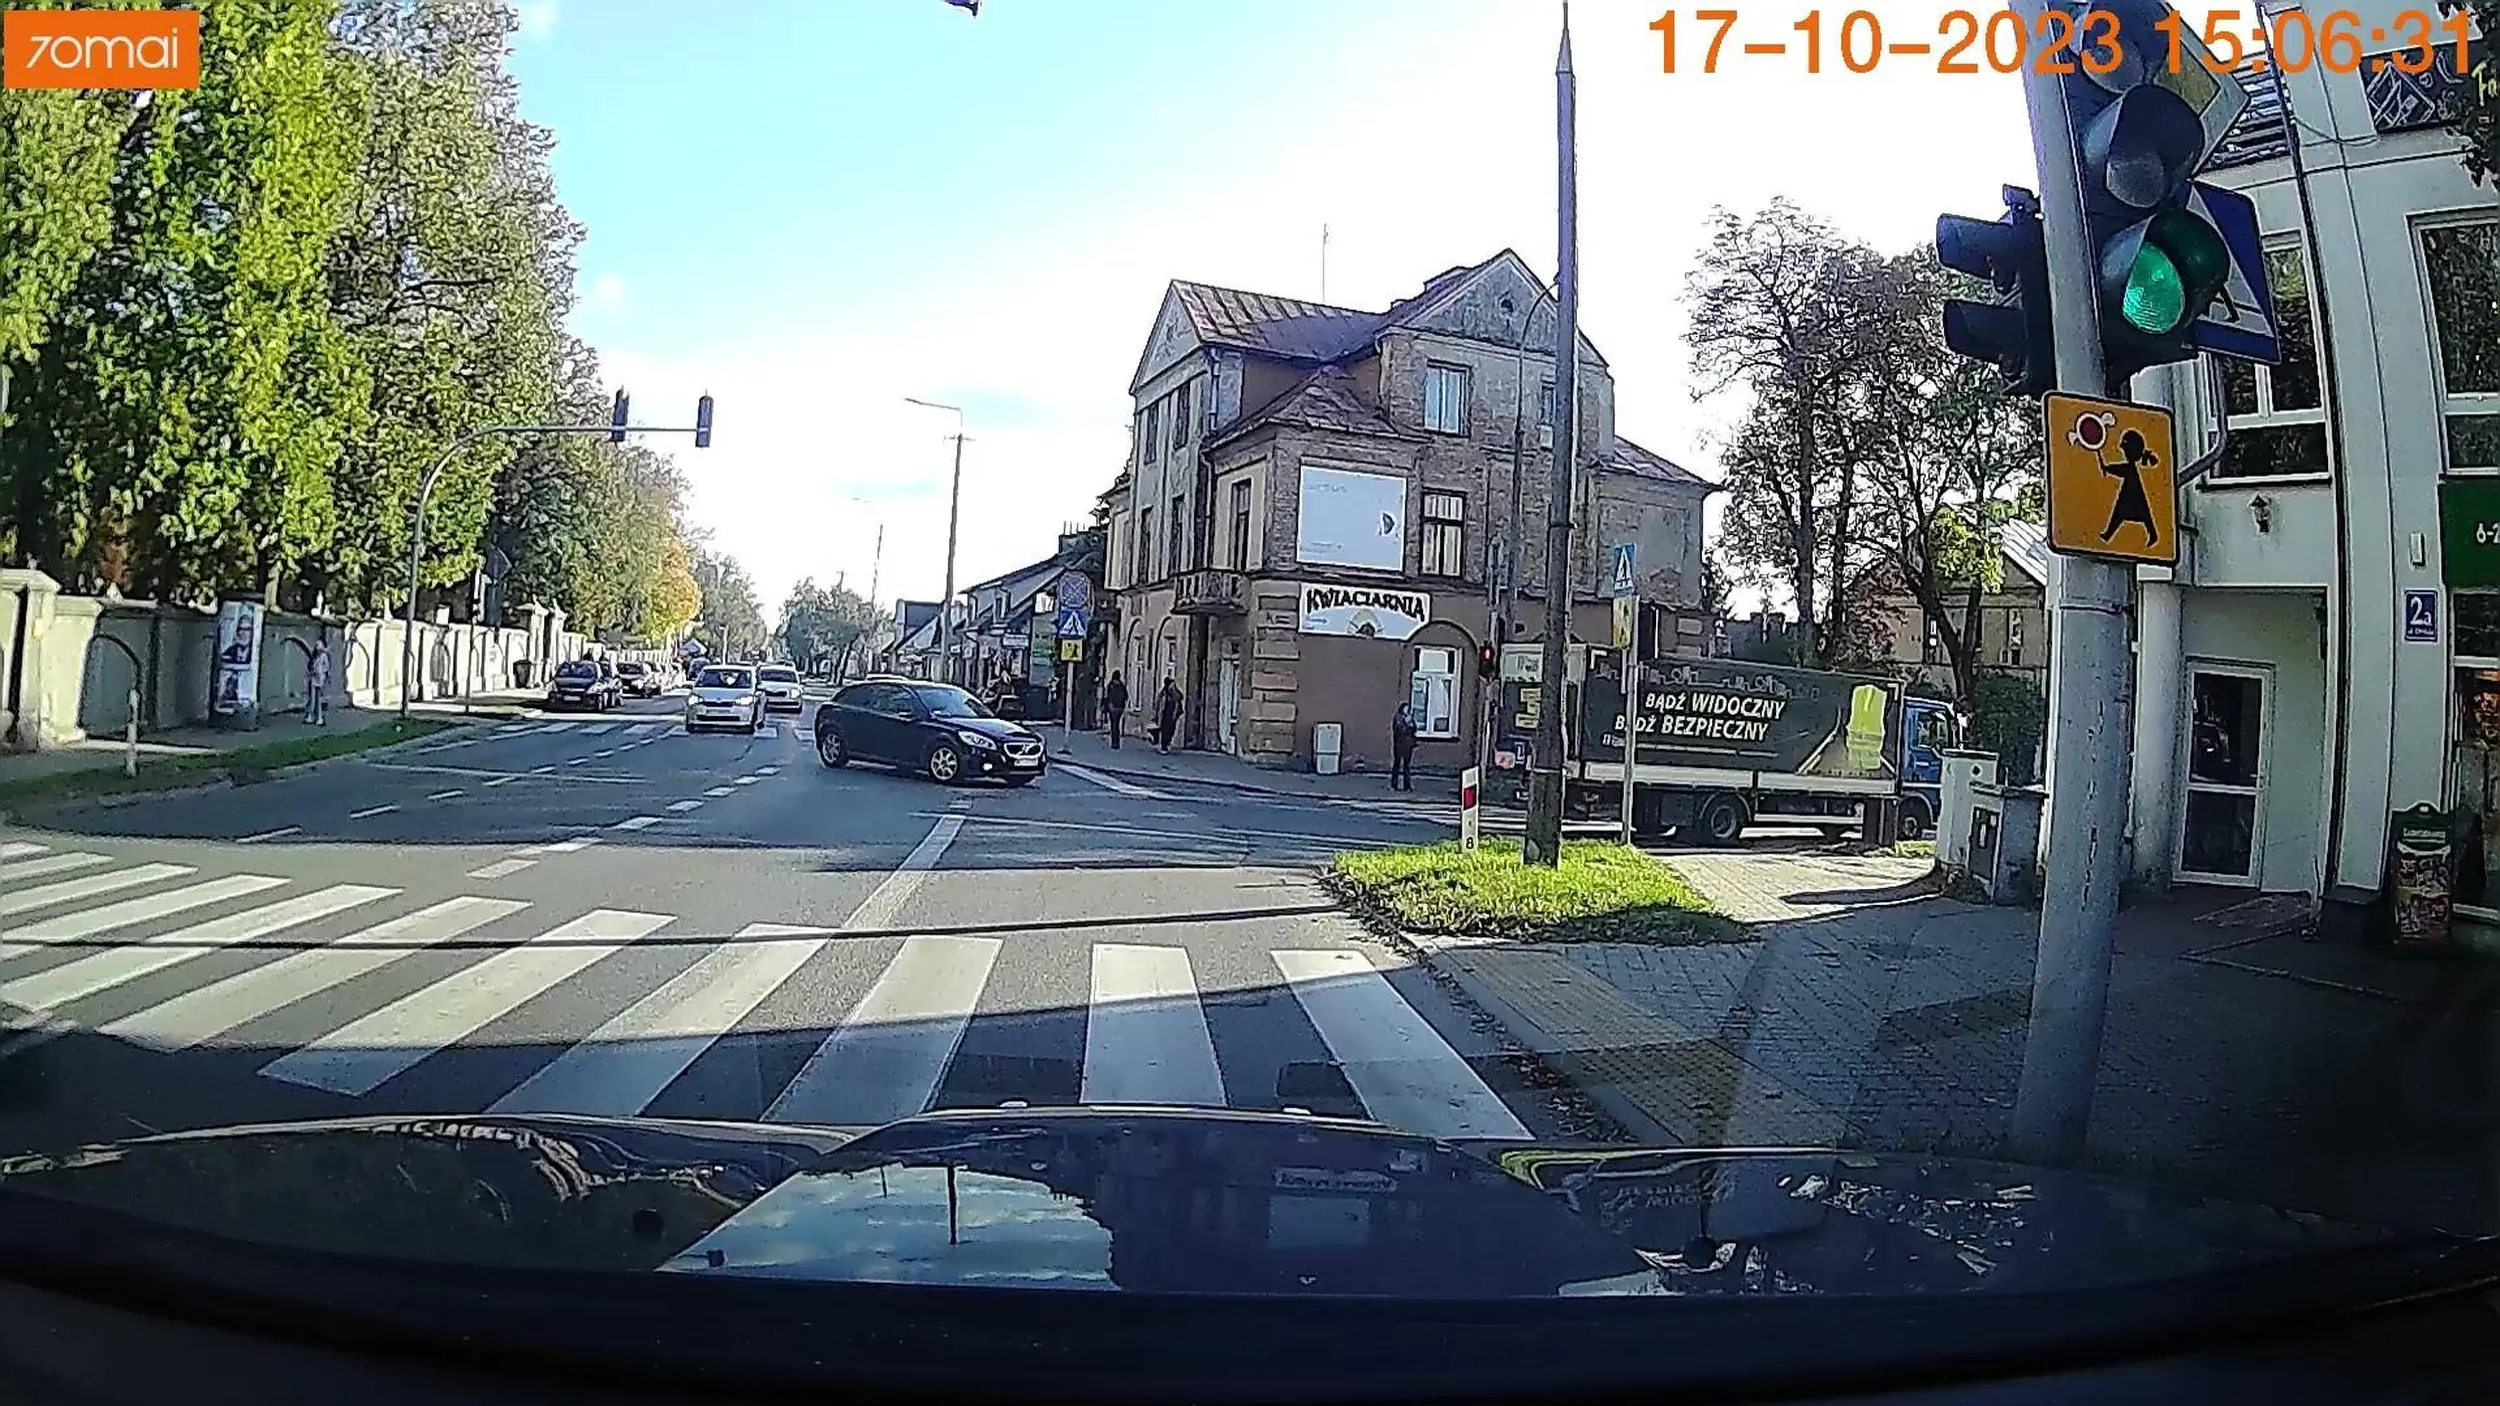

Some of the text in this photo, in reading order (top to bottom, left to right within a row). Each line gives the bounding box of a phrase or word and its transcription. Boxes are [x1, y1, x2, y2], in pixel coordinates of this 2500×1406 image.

[1306, 587, 1425, 622] KWIACIARNIA
[2410, 596, 2432, 626] 2a
[1645, 692, 1786, 720] BĄDŹ WIDOCZNY
[1614, 714, 1769, 741] BDŹ BEZPIECZNY
[1466, 836, 1475, 850] 8
